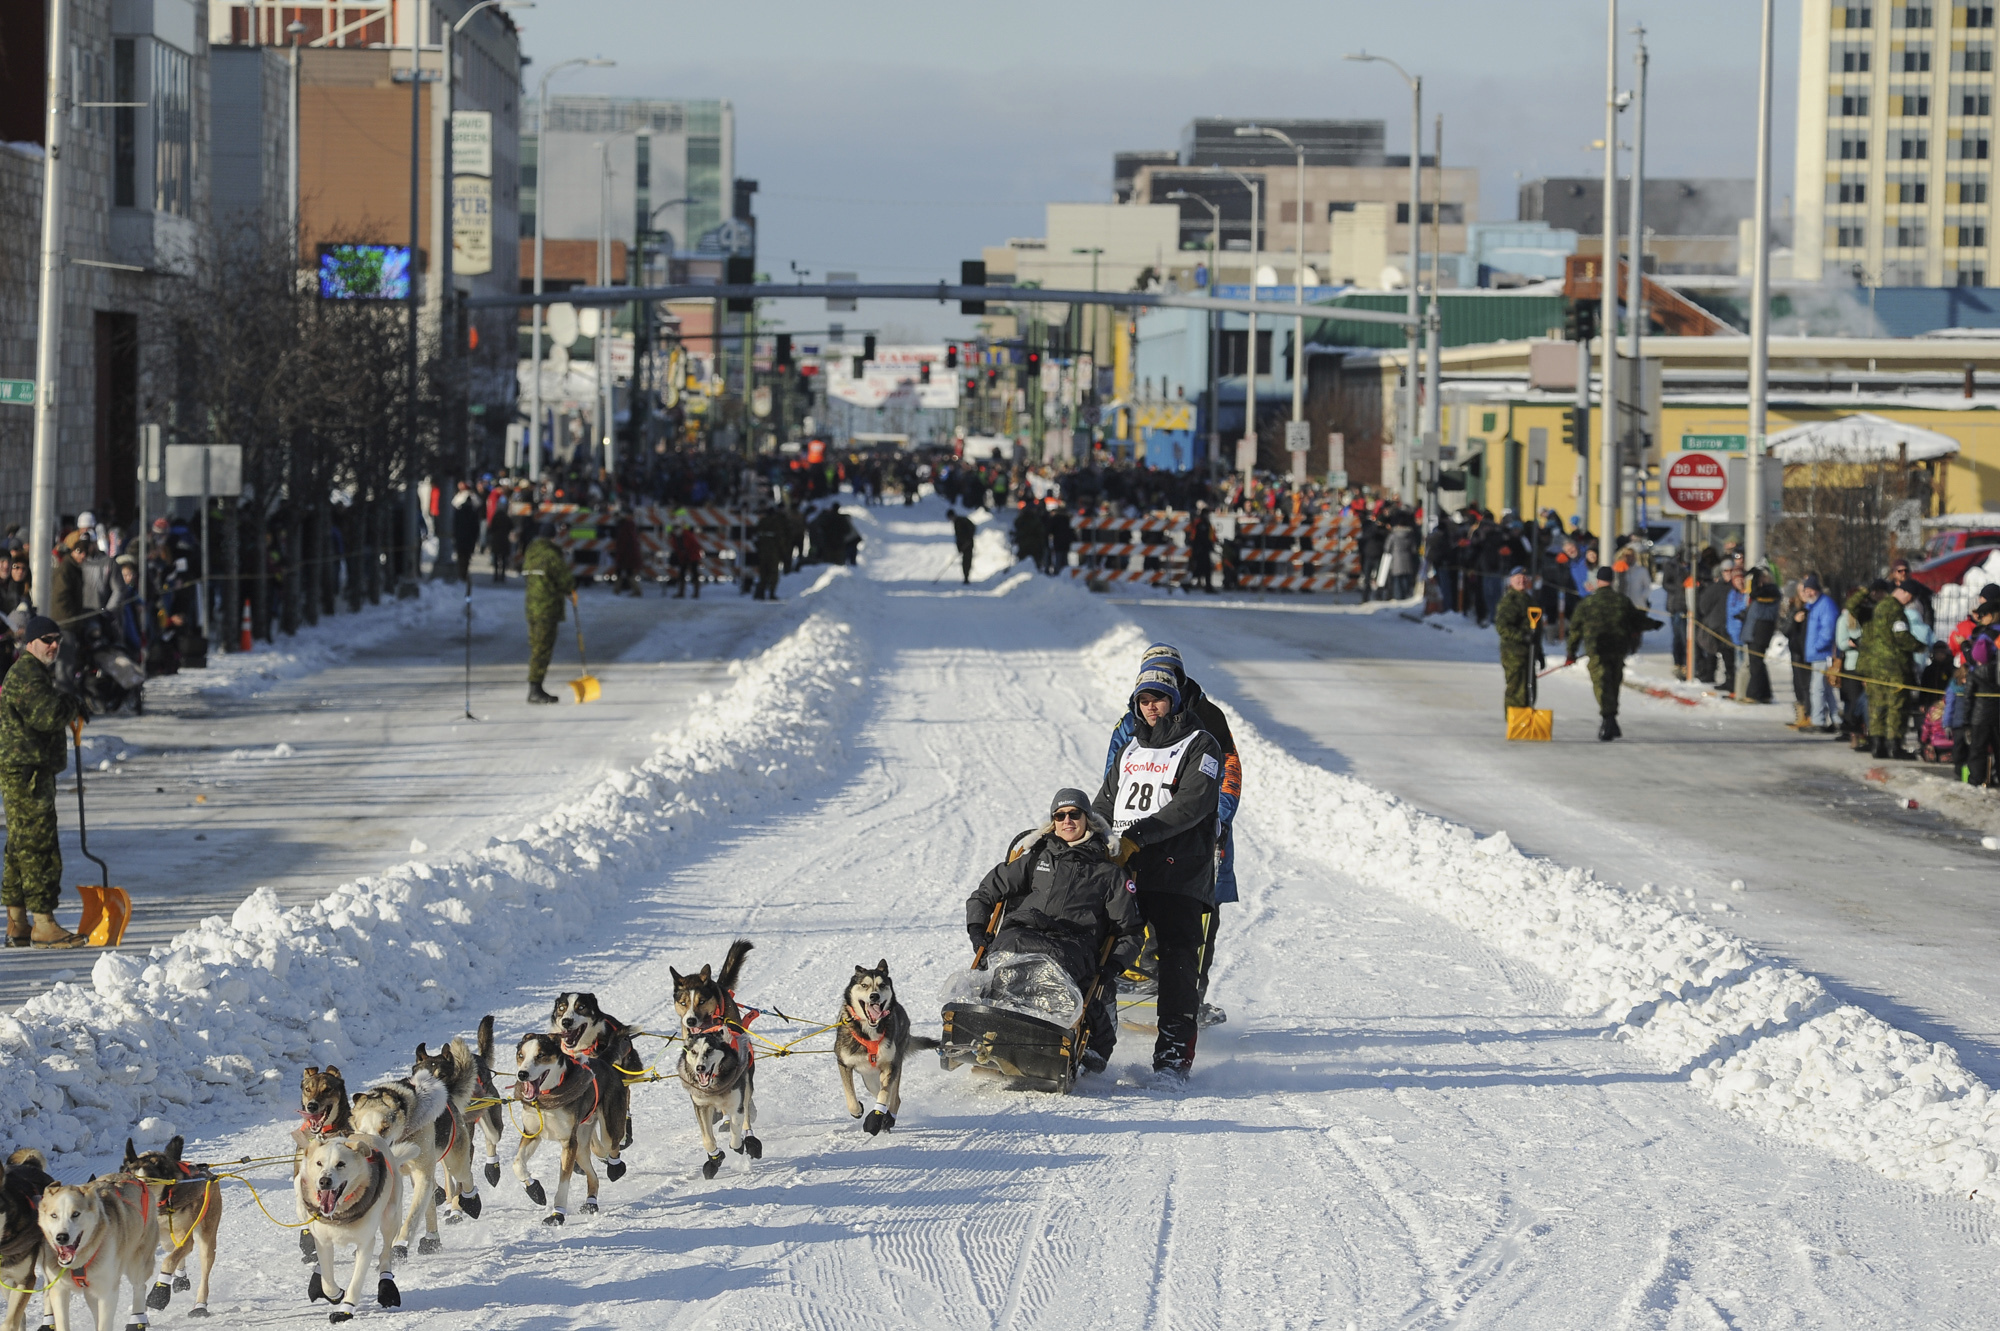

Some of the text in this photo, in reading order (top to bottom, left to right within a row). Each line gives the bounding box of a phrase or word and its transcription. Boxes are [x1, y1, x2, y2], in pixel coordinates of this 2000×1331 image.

[1688, 437, 1723, 448] Barrow
[1674, 463, 1719, 475] DO NOT
[1677, 490, 1714, 502] ENTER
[1124, 781, 1154, 812] 28
